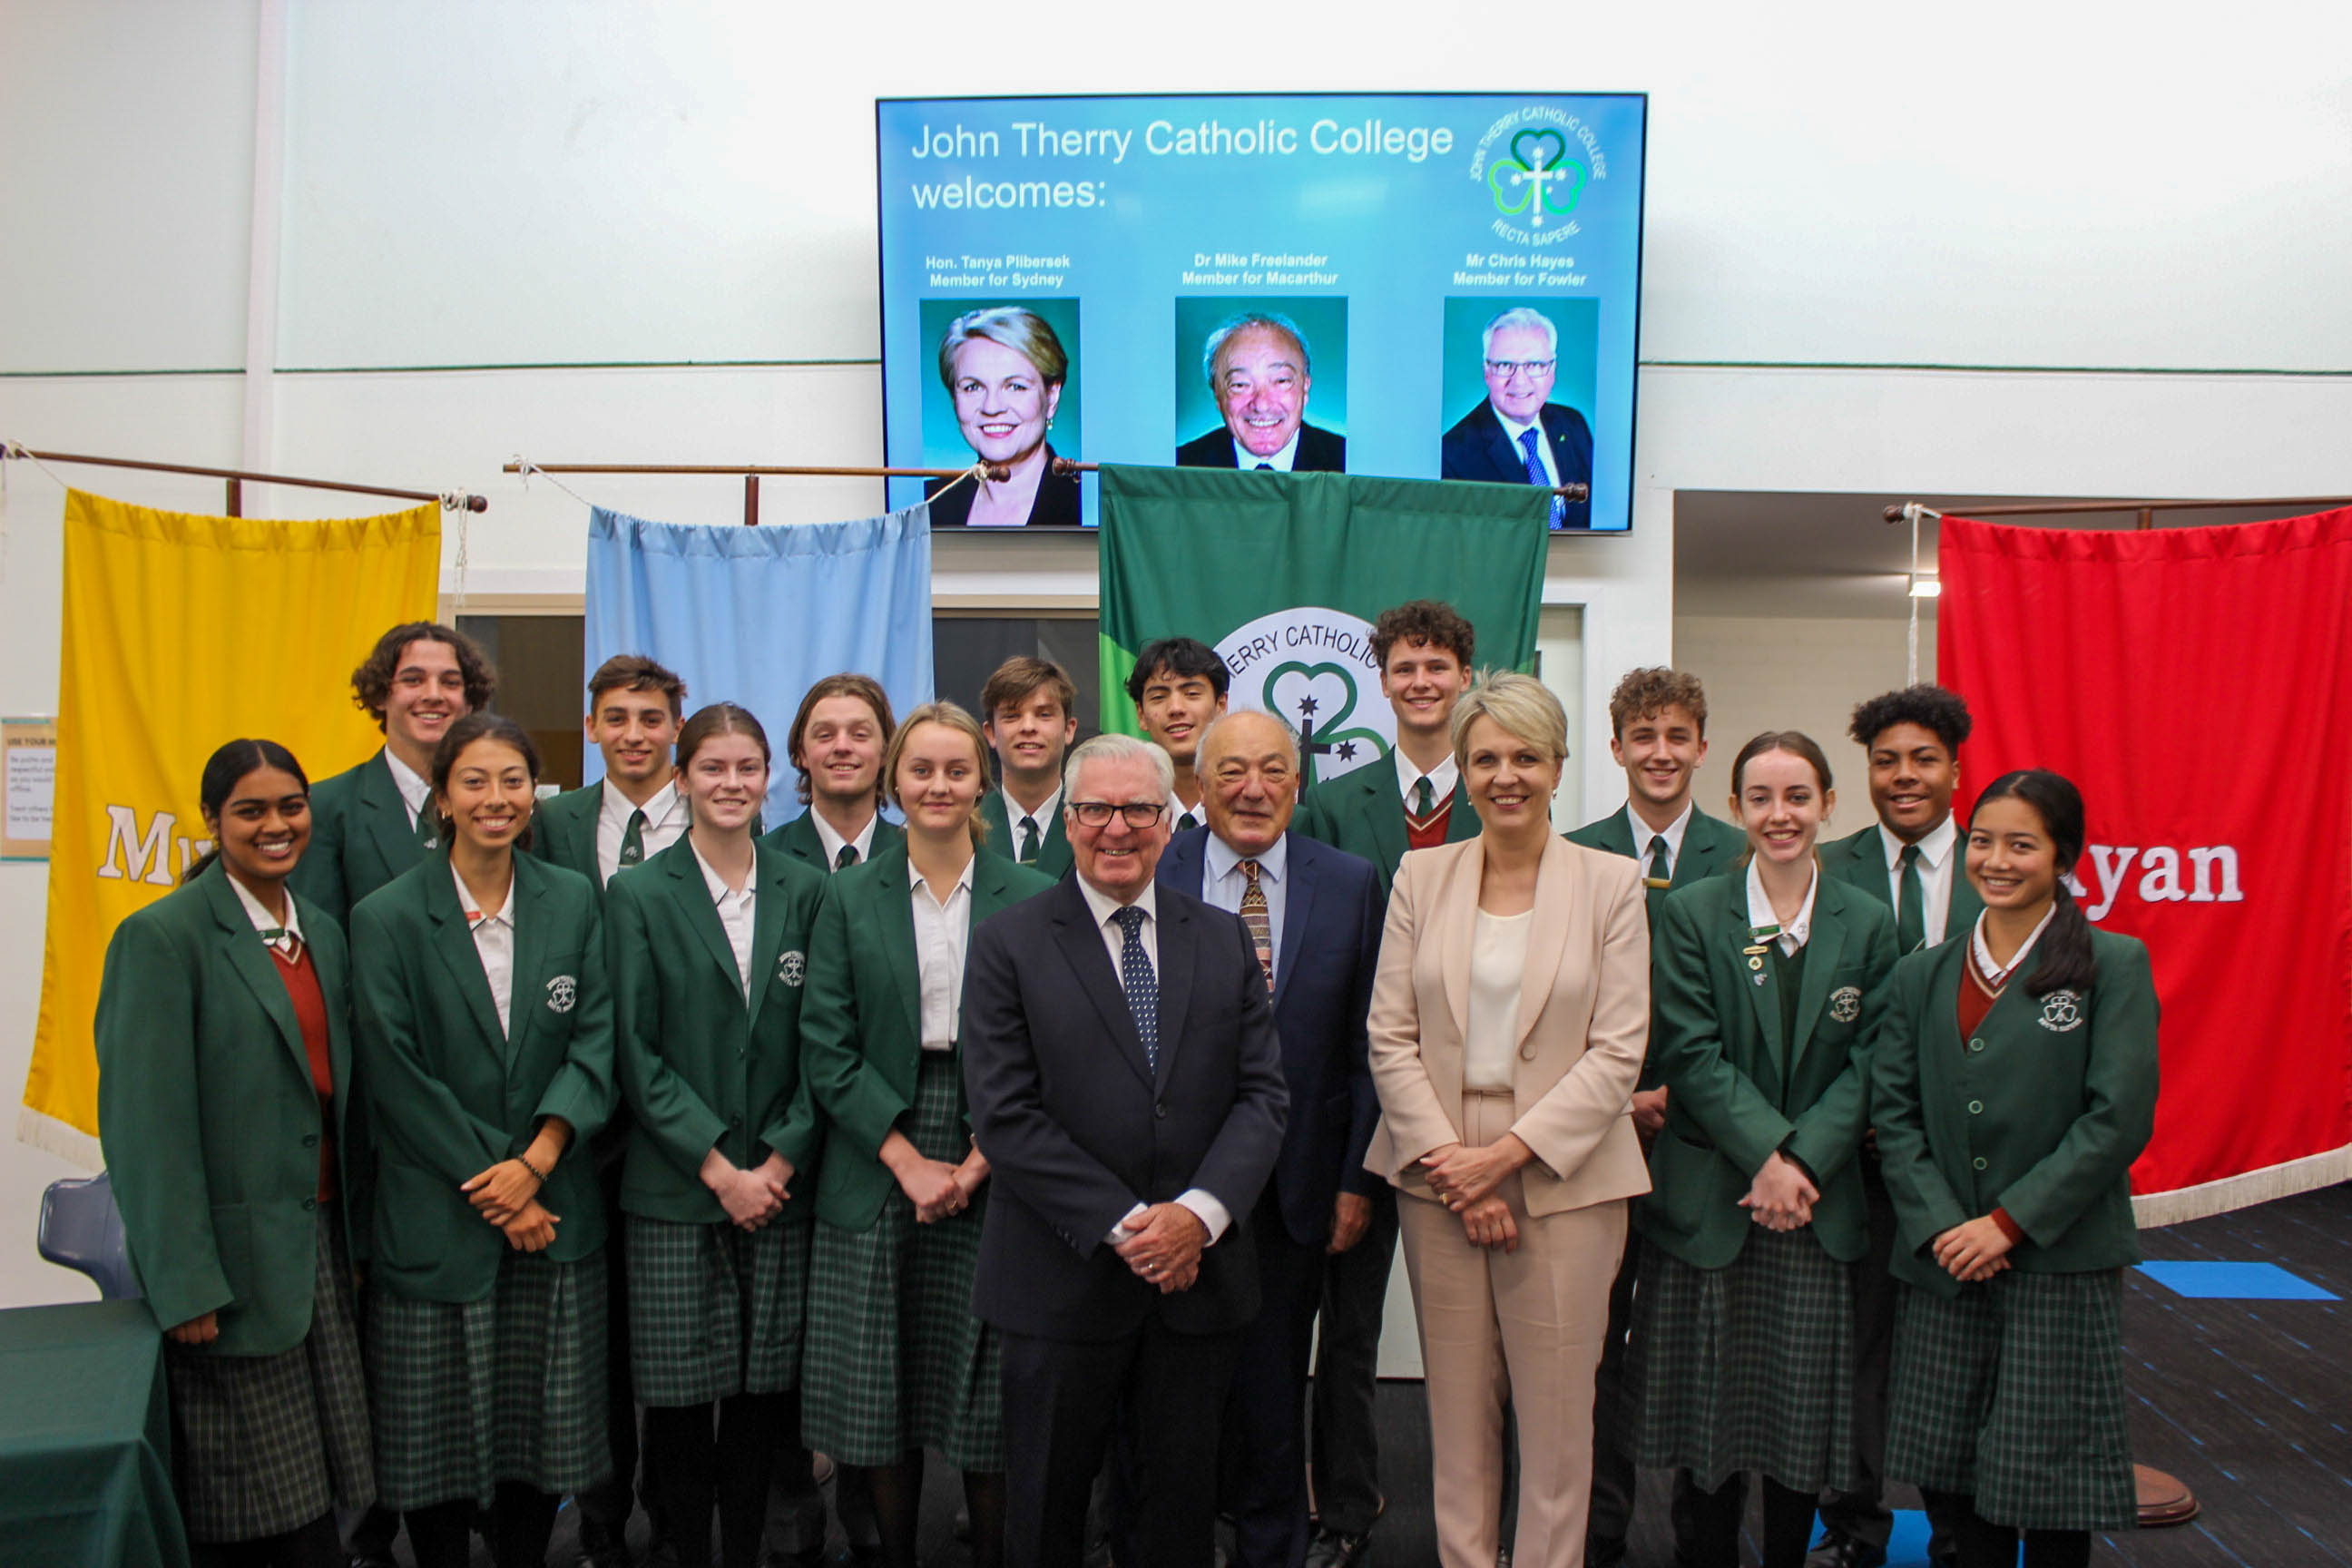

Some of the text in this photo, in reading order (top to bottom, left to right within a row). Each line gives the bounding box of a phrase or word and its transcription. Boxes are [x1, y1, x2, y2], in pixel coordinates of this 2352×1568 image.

[911, 119, 1454, 164] John Therry Catholic College
[1522, 106, 1581, 132] CATHOLIC
[1576, 126, 1607, 181] COLLEGE
[911, 174, 1105, 209] welcomes:
[1492, 218, 1582, 247] RECTA SAPERE
[926, 254, 1070, 272] Hon. Tanya Plibersek
[1194, 253, 1328, 267] Dr Mike Freelander
[1465, 253, 1574, 271] Mr Chris Hayes
[929, 273, 1063, 289] Member for Sydney
[1182, 271, 1338, 285] Member for Macarthur
[1453, 272, 1588, 286] Member for Fowler
[1226, 630, 1279, 679] ERRY
[2059, 844, 2245, 922] yan
